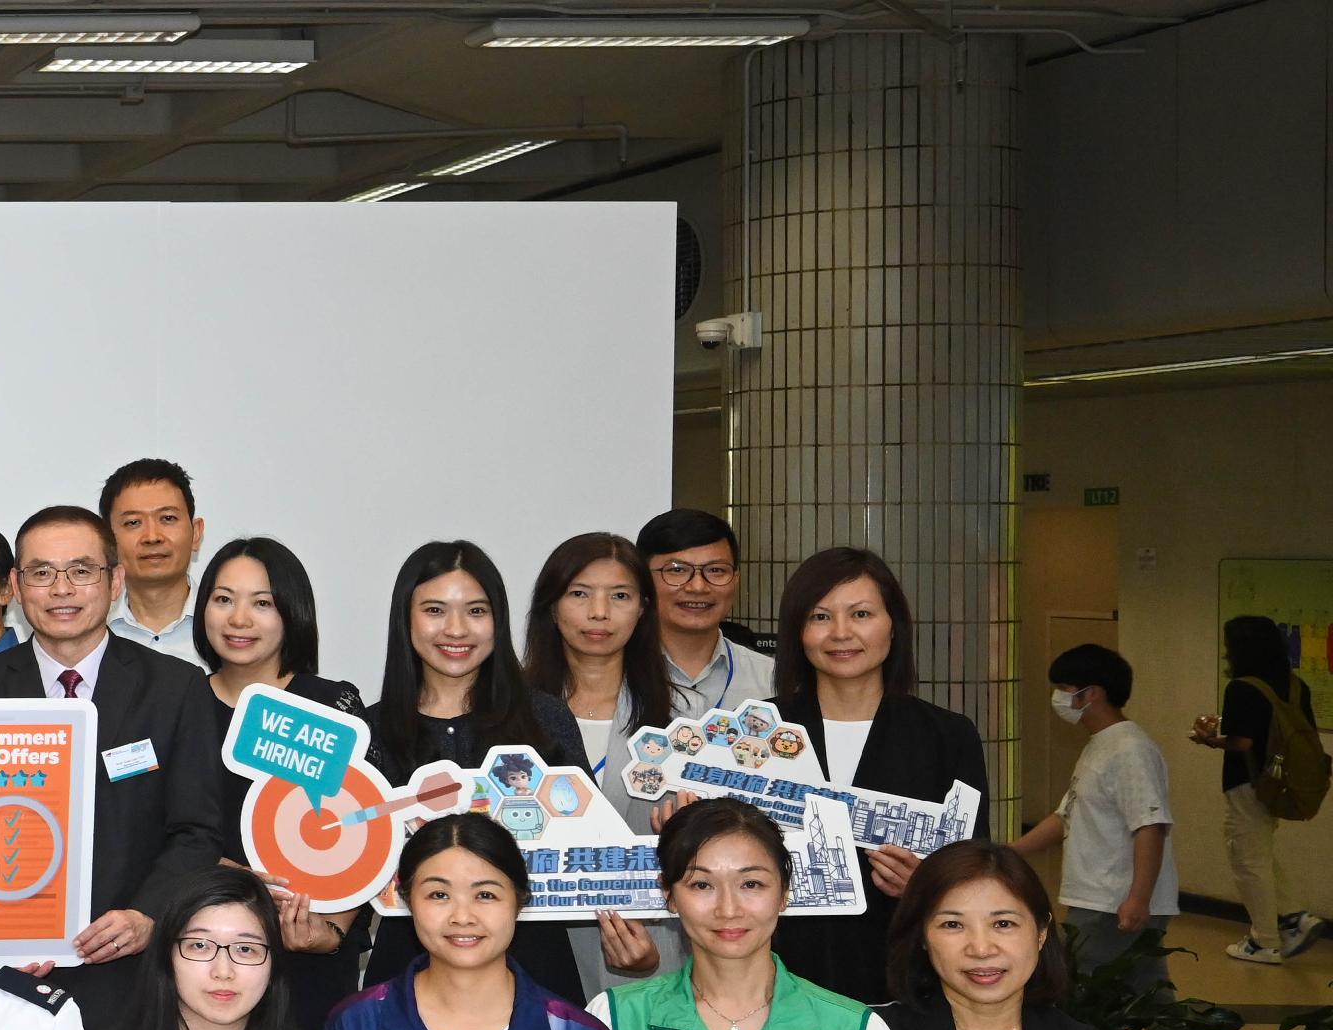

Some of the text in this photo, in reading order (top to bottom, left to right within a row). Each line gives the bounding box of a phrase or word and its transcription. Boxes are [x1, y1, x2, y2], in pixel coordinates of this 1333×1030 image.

[261, 709, 339, 754] WE ARE
[251, 737, 326, 780] HIRING!
[563, 845, 661, 873] 共建未
[547, 879, 577, 892] the
[577, 893, 633, 906] Future
